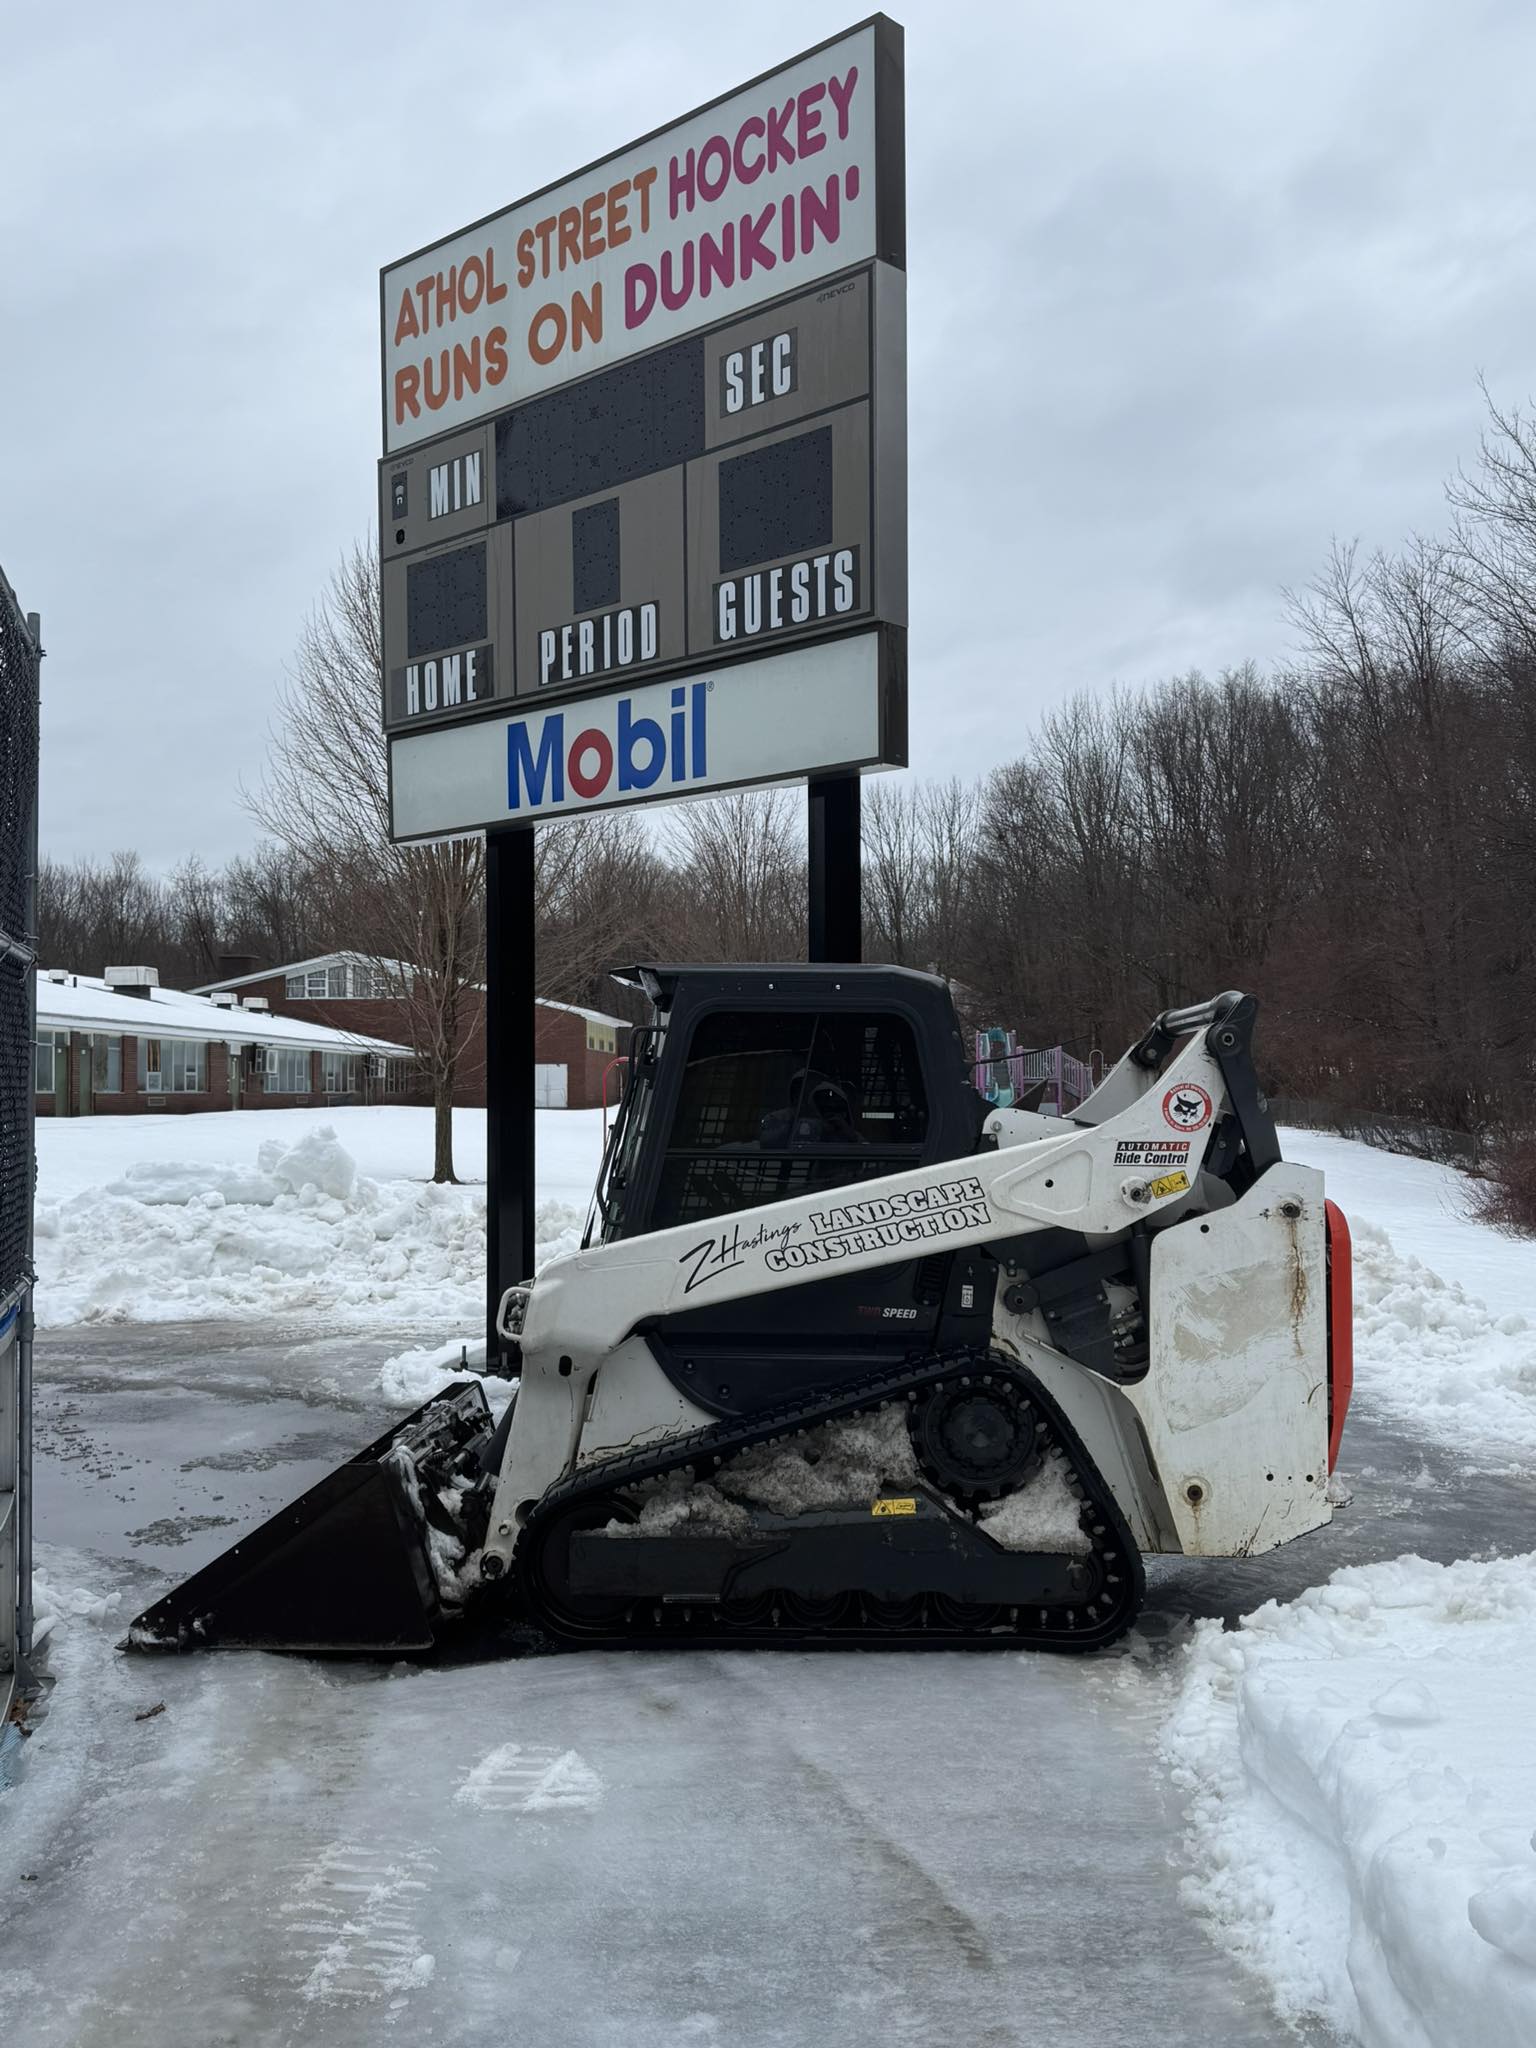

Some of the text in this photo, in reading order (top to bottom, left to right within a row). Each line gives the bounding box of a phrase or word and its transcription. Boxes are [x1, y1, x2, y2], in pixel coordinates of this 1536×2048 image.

[395, 66, 858, 347] ATHOL STREET HOCKEY
[395, 165, 860, 425] RUNS ON DUNKIN'
[726, 333, 791, 413] SEC
[430, 452, 480, 518] MIN
[719, 550, 853, 640] GUESTS
[541, 603, 656, 684] PERIOD
[406, 650, 477, 715] HOME
[1114, 1152, 1189, 1164] Ride Control
[1118, 1142, 1189, 1151] AUTOMATIC
[765, 1202, 991, 1272] CONSTRUCTION
[809, 1177, 986, 1235] LANDSCAPE
[882, 1307, 917, 1320] SPEED
